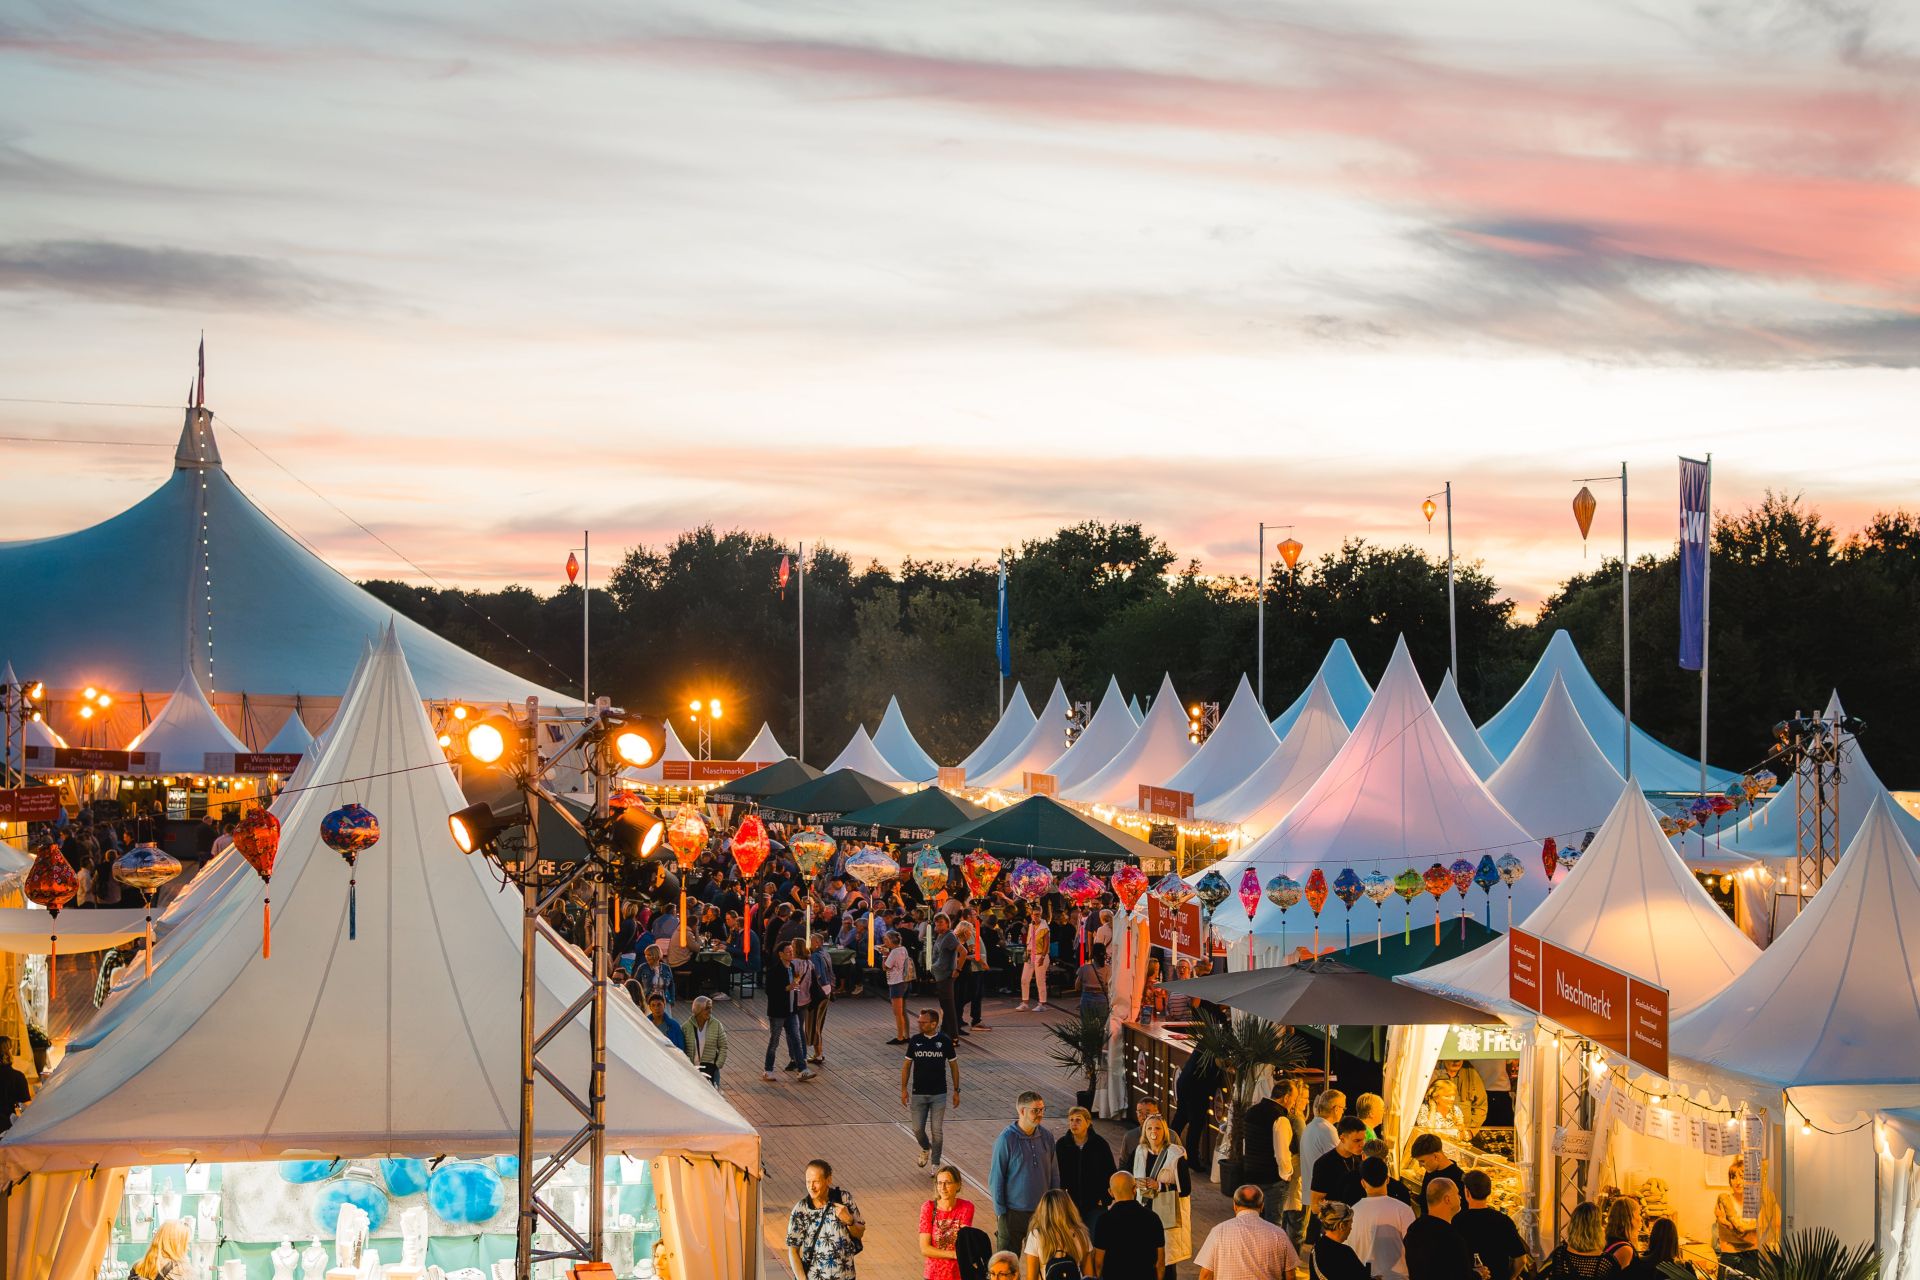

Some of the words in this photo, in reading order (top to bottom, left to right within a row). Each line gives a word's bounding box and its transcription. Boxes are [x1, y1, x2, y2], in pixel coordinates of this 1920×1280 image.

[250, 755, 281, 763] Weinbar
[702, 766, 745, 775] Naschmarkt
[1556, 968, 1612, 1020] Naschmarkt
[1483, 1030, 1526, 1052] FIEG
